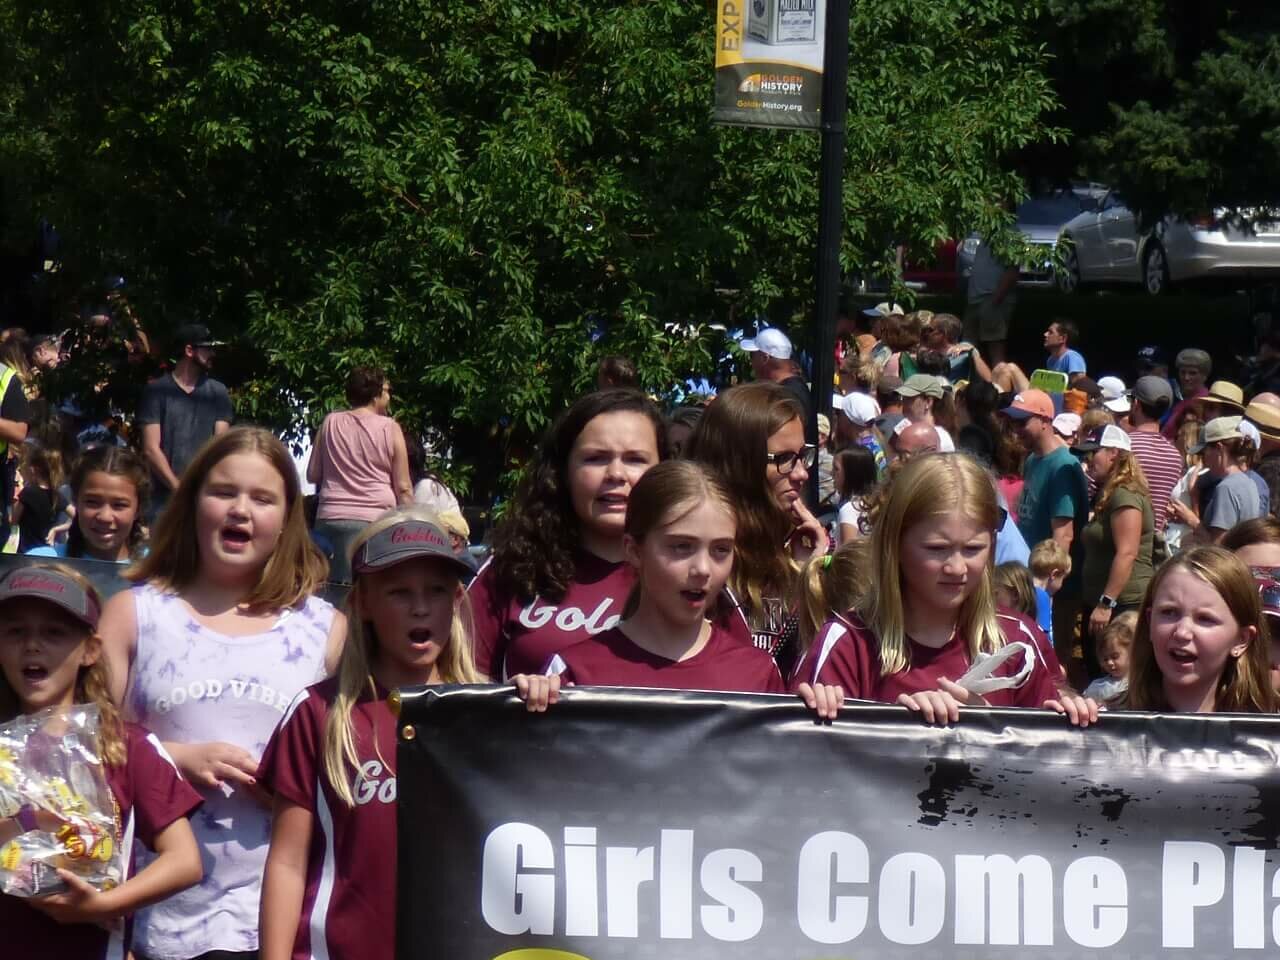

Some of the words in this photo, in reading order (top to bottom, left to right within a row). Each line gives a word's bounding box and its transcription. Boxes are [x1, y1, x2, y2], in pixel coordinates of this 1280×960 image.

[760, 81, 802, 91] HISTORY
[155, 679, 223, 713] GOOD
[481, 822, 764, 942] Girls
[799, 831, 1130, 949] Come
